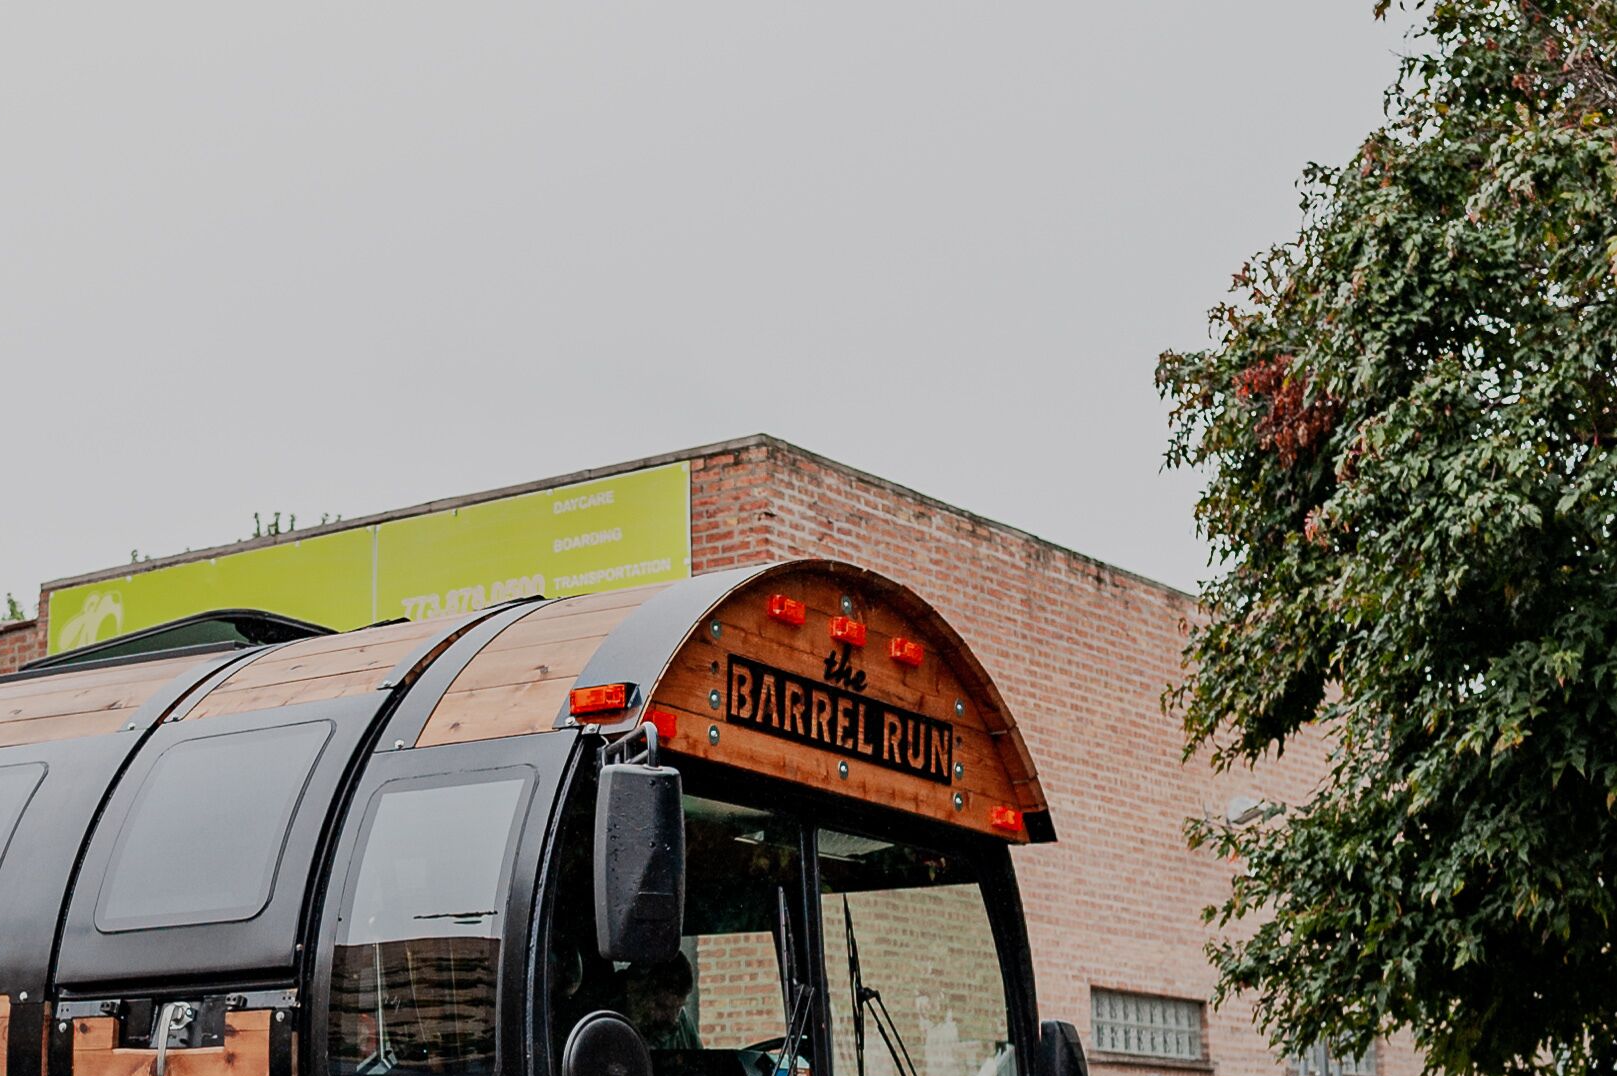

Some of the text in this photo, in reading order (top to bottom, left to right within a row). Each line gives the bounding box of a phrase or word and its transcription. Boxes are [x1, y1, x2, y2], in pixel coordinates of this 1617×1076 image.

[552, 490, 615, 514] DAYCARE
[552, 527, 623, 553] BOARDING
[552, 557, 672, 591] TRANSPORTATION
[824, 645, 868, 692] the
[730, 663, 951, 778] BARREL RUN
